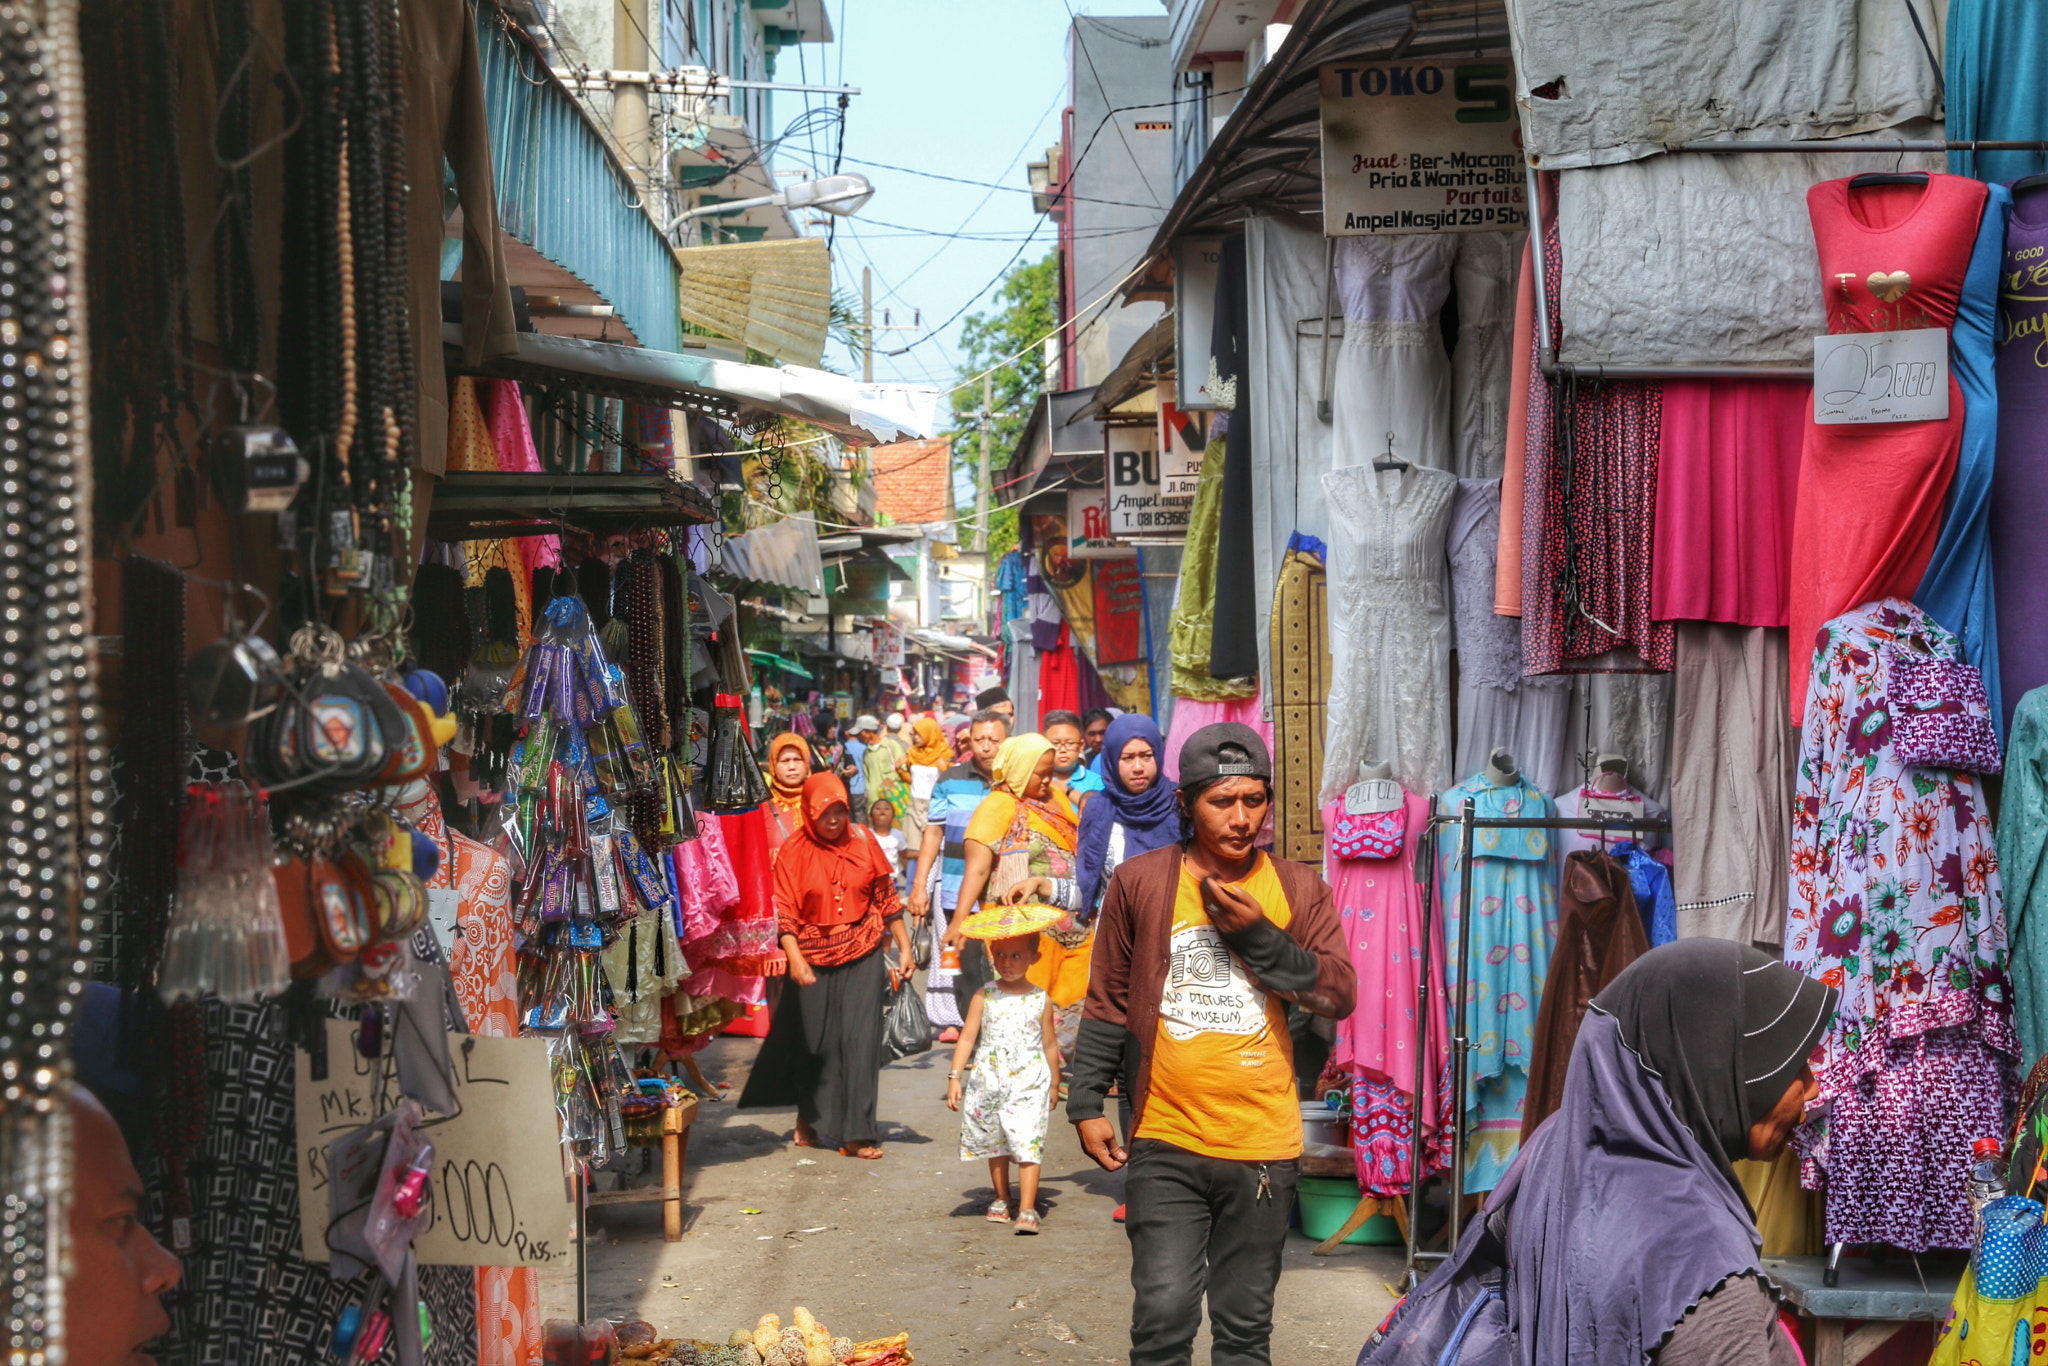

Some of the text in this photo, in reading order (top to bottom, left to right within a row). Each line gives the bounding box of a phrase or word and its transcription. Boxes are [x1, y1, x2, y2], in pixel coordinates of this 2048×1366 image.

[1335, 66, 1444, 98] TOKO
[1370, 171, 1407, 189] Pria
[1410, 170, 1421, 187] &
[1446, 186, 1524, 205] Partai &
[1345, 211, 1398, 232] Ampel
[1401, 209, 1457, 230] Masjid
[2014, 246, 2045, 261] GOOD
[1112, 494, 1159, 512] Ampel
[1166, 991, 1183, 1005] NO
[1169, 1007, 1242, 1024] IN MUSEUM
